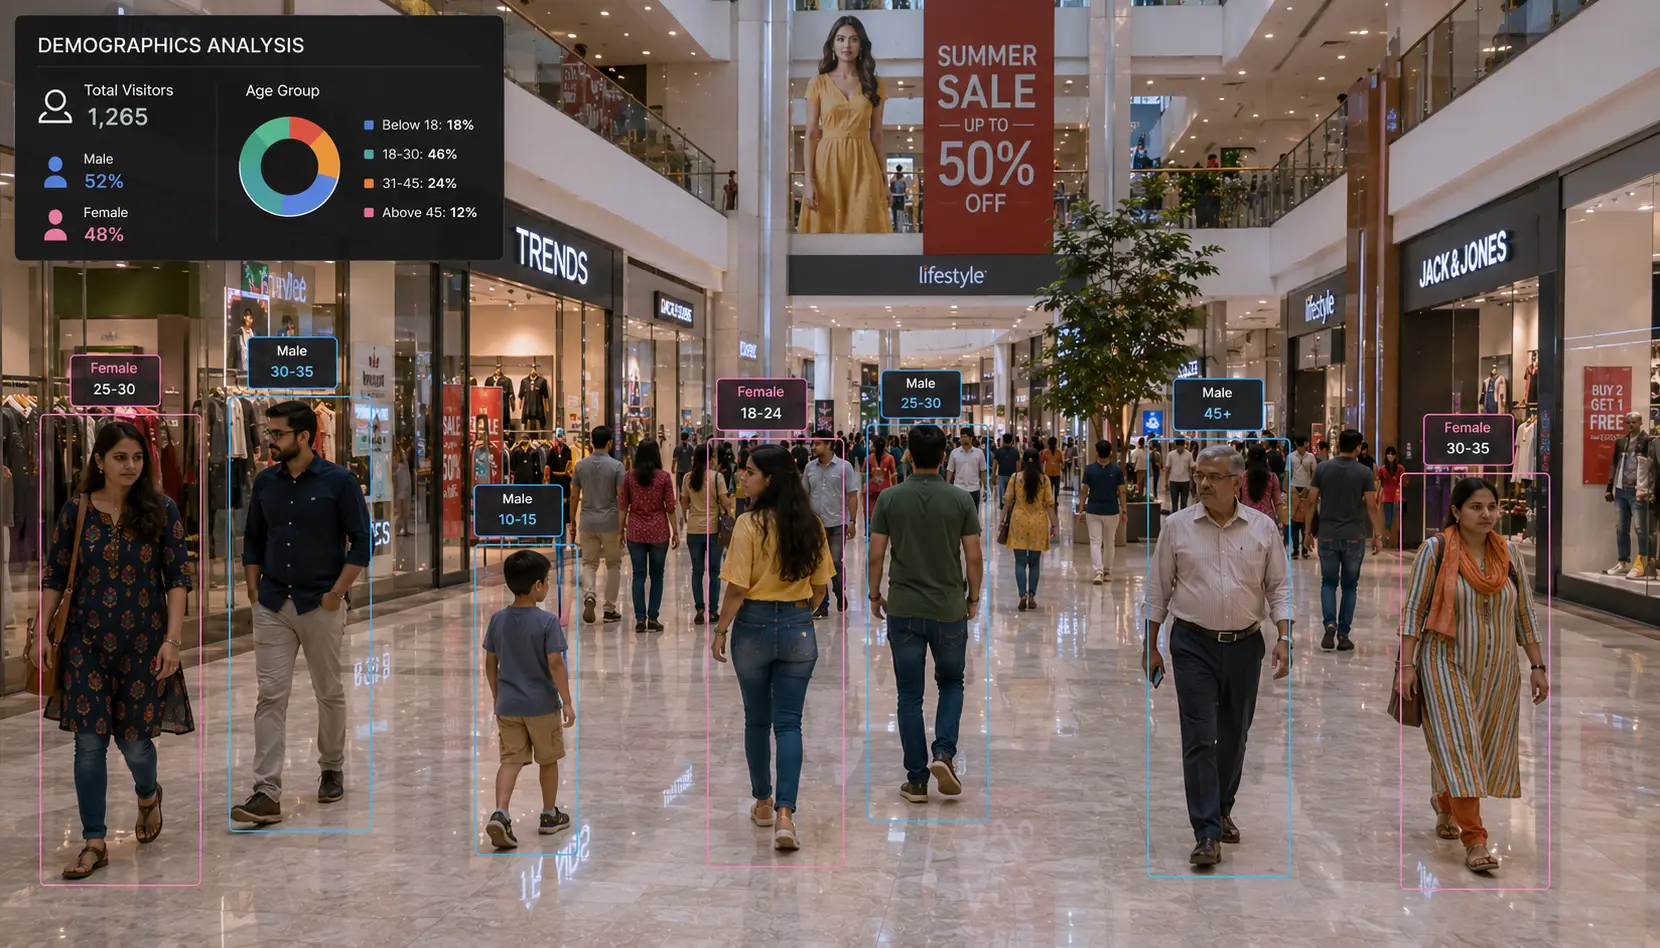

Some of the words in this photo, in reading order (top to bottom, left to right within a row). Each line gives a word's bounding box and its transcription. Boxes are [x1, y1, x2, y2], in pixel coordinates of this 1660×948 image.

[937, 44, 1037, 67] SUMMER
[937, 74, 1036, 110] SALE
[964, 117, 985, 133] UP
[988, 117, 1009, 133] TO
[938, 139, 1035, 187] 50%
[965, 193, 1007, 214] OFF
[516, 226, 588, 285] TRENDS
[919, 264, 985, 289] lifestyle
[1305, 289, 1335, 325] lifestyle
[1592, 384, 1614, 396] BUY
[1616, 384, 1624, 396] 2
[1591, 398, 1615, 411] GET
[1617, 398, 1623, 411] 1
[442, 415, 461, 436] SALE
[1590, 414, 1624, 431] FREE
